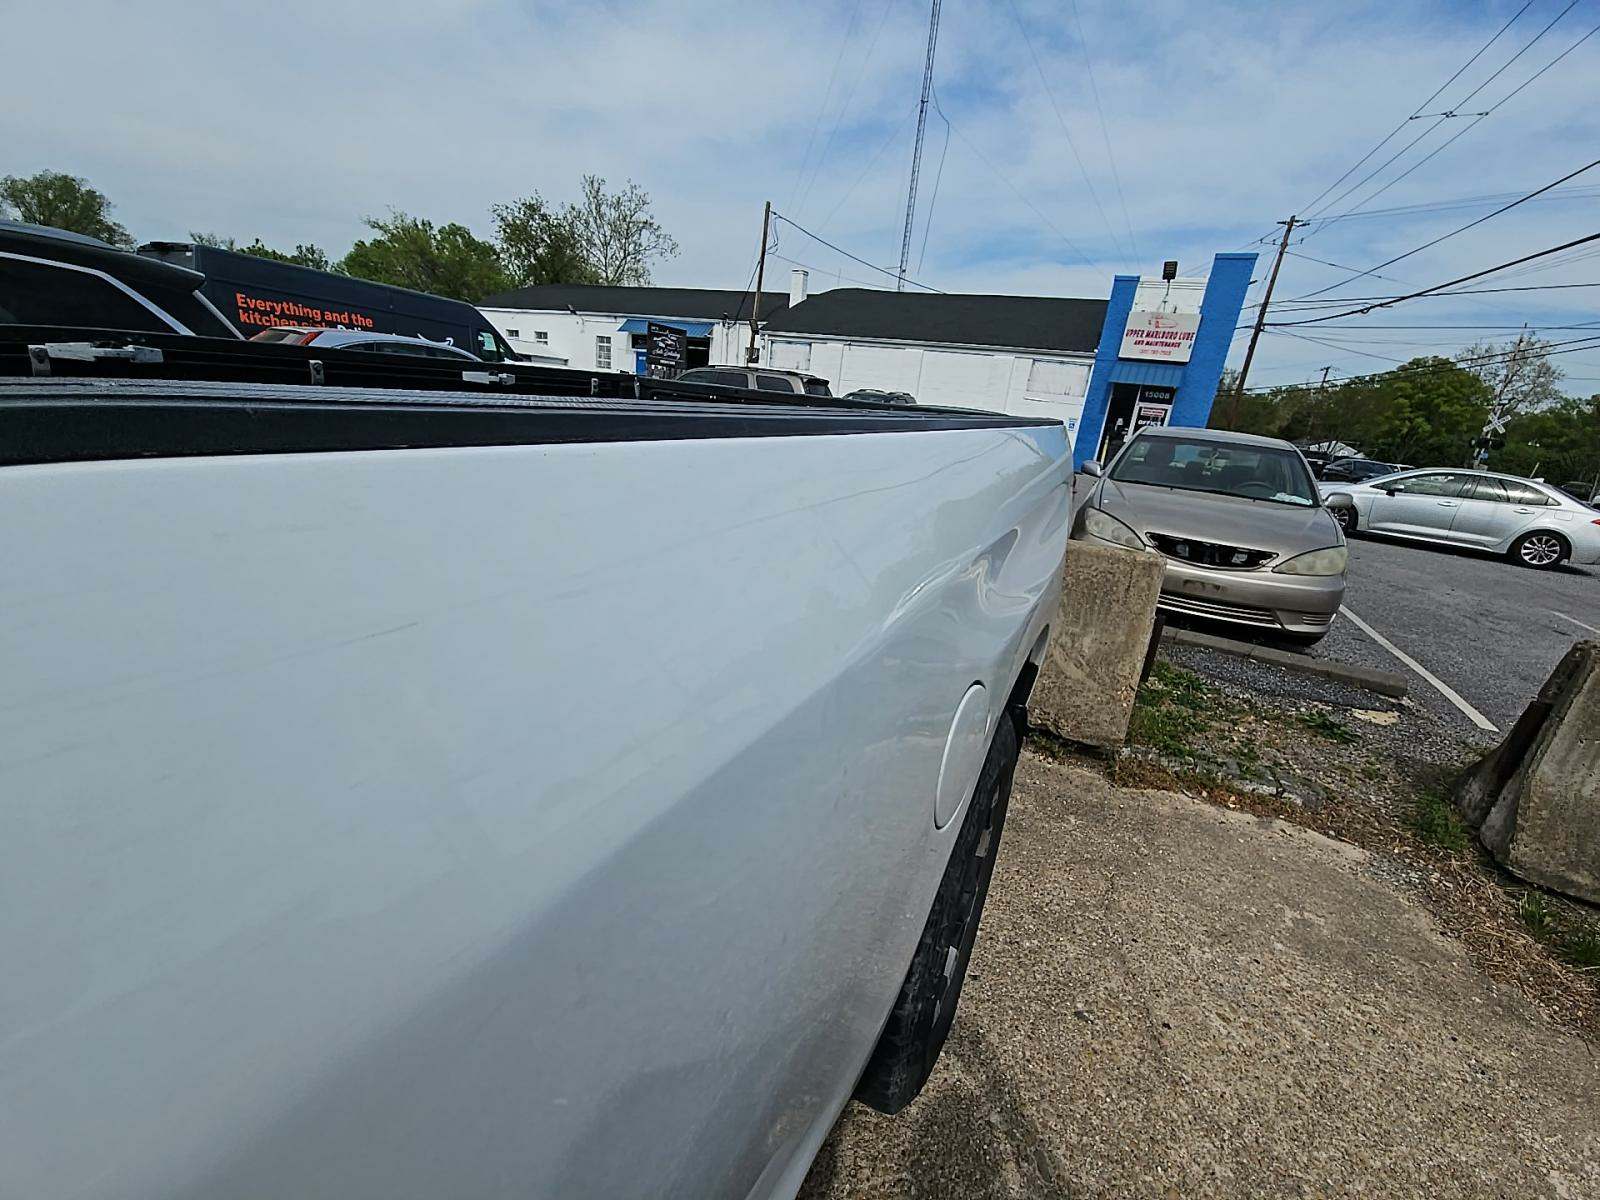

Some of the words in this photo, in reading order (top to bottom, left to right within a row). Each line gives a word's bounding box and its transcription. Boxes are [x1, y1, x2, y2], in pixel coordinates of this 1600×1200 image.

[236, 293, 321, 321] Everything
[324, 310, 349, 324] and
[351, 313, 374, 327] the
[239, 309, 298, 327] kitchen
[1126, 329, 1145, 338] UPPER
[1145, 330, 1178, 340] MARLBORO
[1178, 332, 1195, 341] LUBE
[1145, 340, 1182, 348] MAINTENANCE
